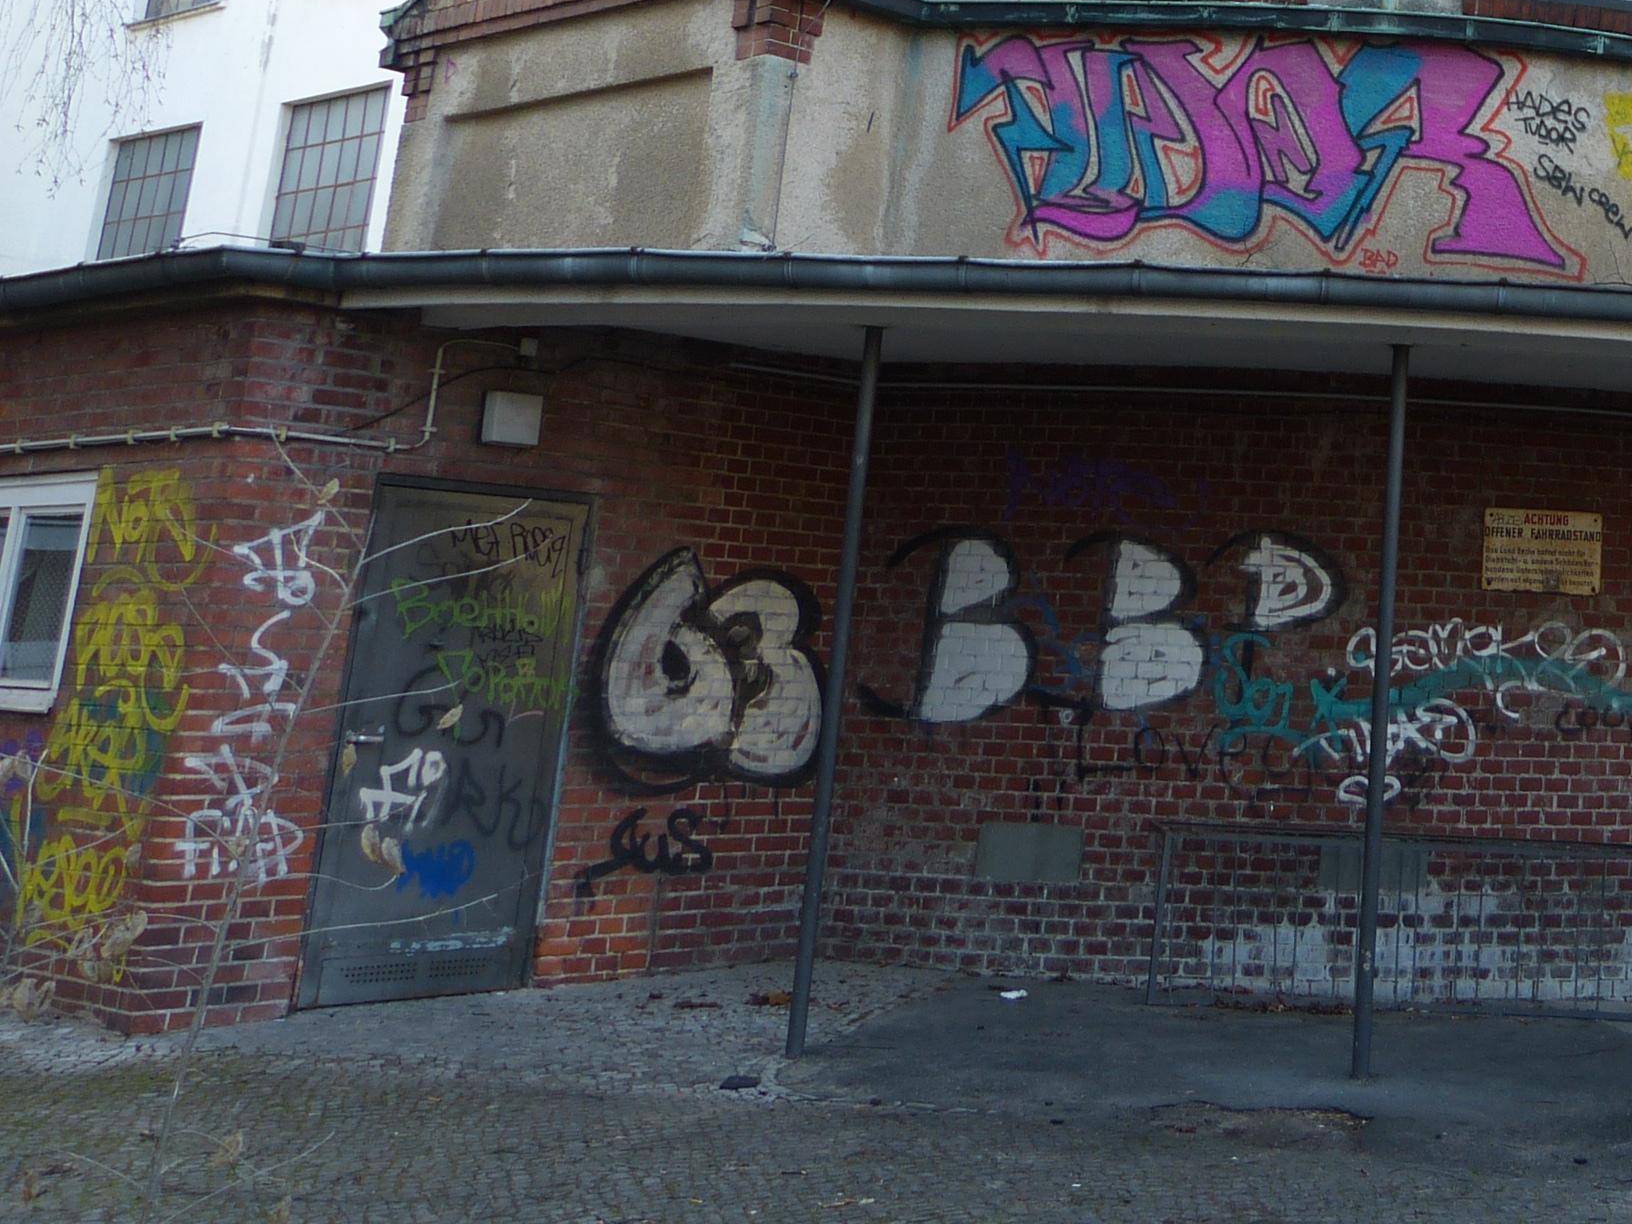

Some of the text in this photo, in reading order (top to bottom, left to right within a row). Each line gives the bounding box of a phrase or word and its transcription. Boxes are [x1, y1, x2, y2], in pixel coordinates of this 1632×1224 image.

[1514, 116, 1576, 154] TUDOR
[1524, 513, 1569, 526] ACHTUNG
[1484, 526, 1601, 542] OFFENER FAHRRADSTAND
